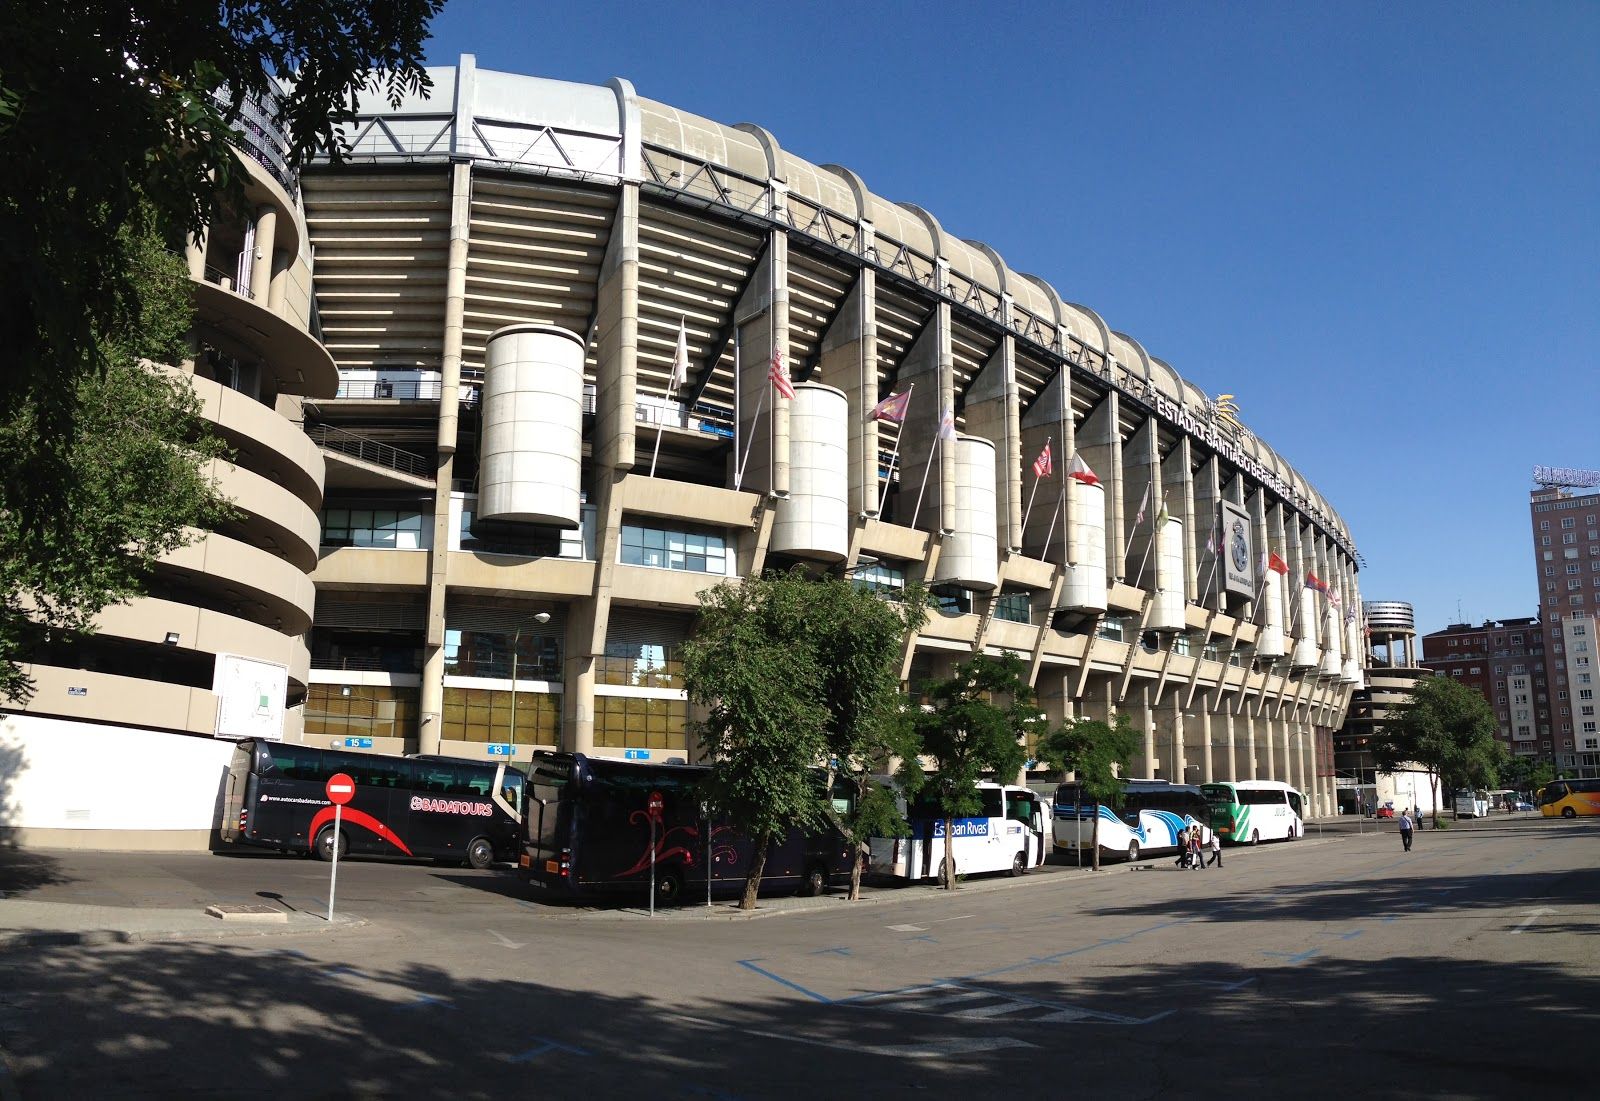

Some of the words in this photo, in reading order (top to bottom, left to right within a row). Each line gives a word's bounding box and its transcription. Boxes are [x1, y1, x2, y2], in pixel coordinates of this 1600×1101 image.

[1157, 396, 1206, 441] ESTADIO
[1206, 429, 1251, 472] SANTIAGO
[1533, 465, 1600, 483] SAMSUNG
[350, 738, 360, 747] 15
[494, 745, 503, 755] 13
[630, 750, 638, 759] 11
[421, 798, 493, 817] BADATOURS
